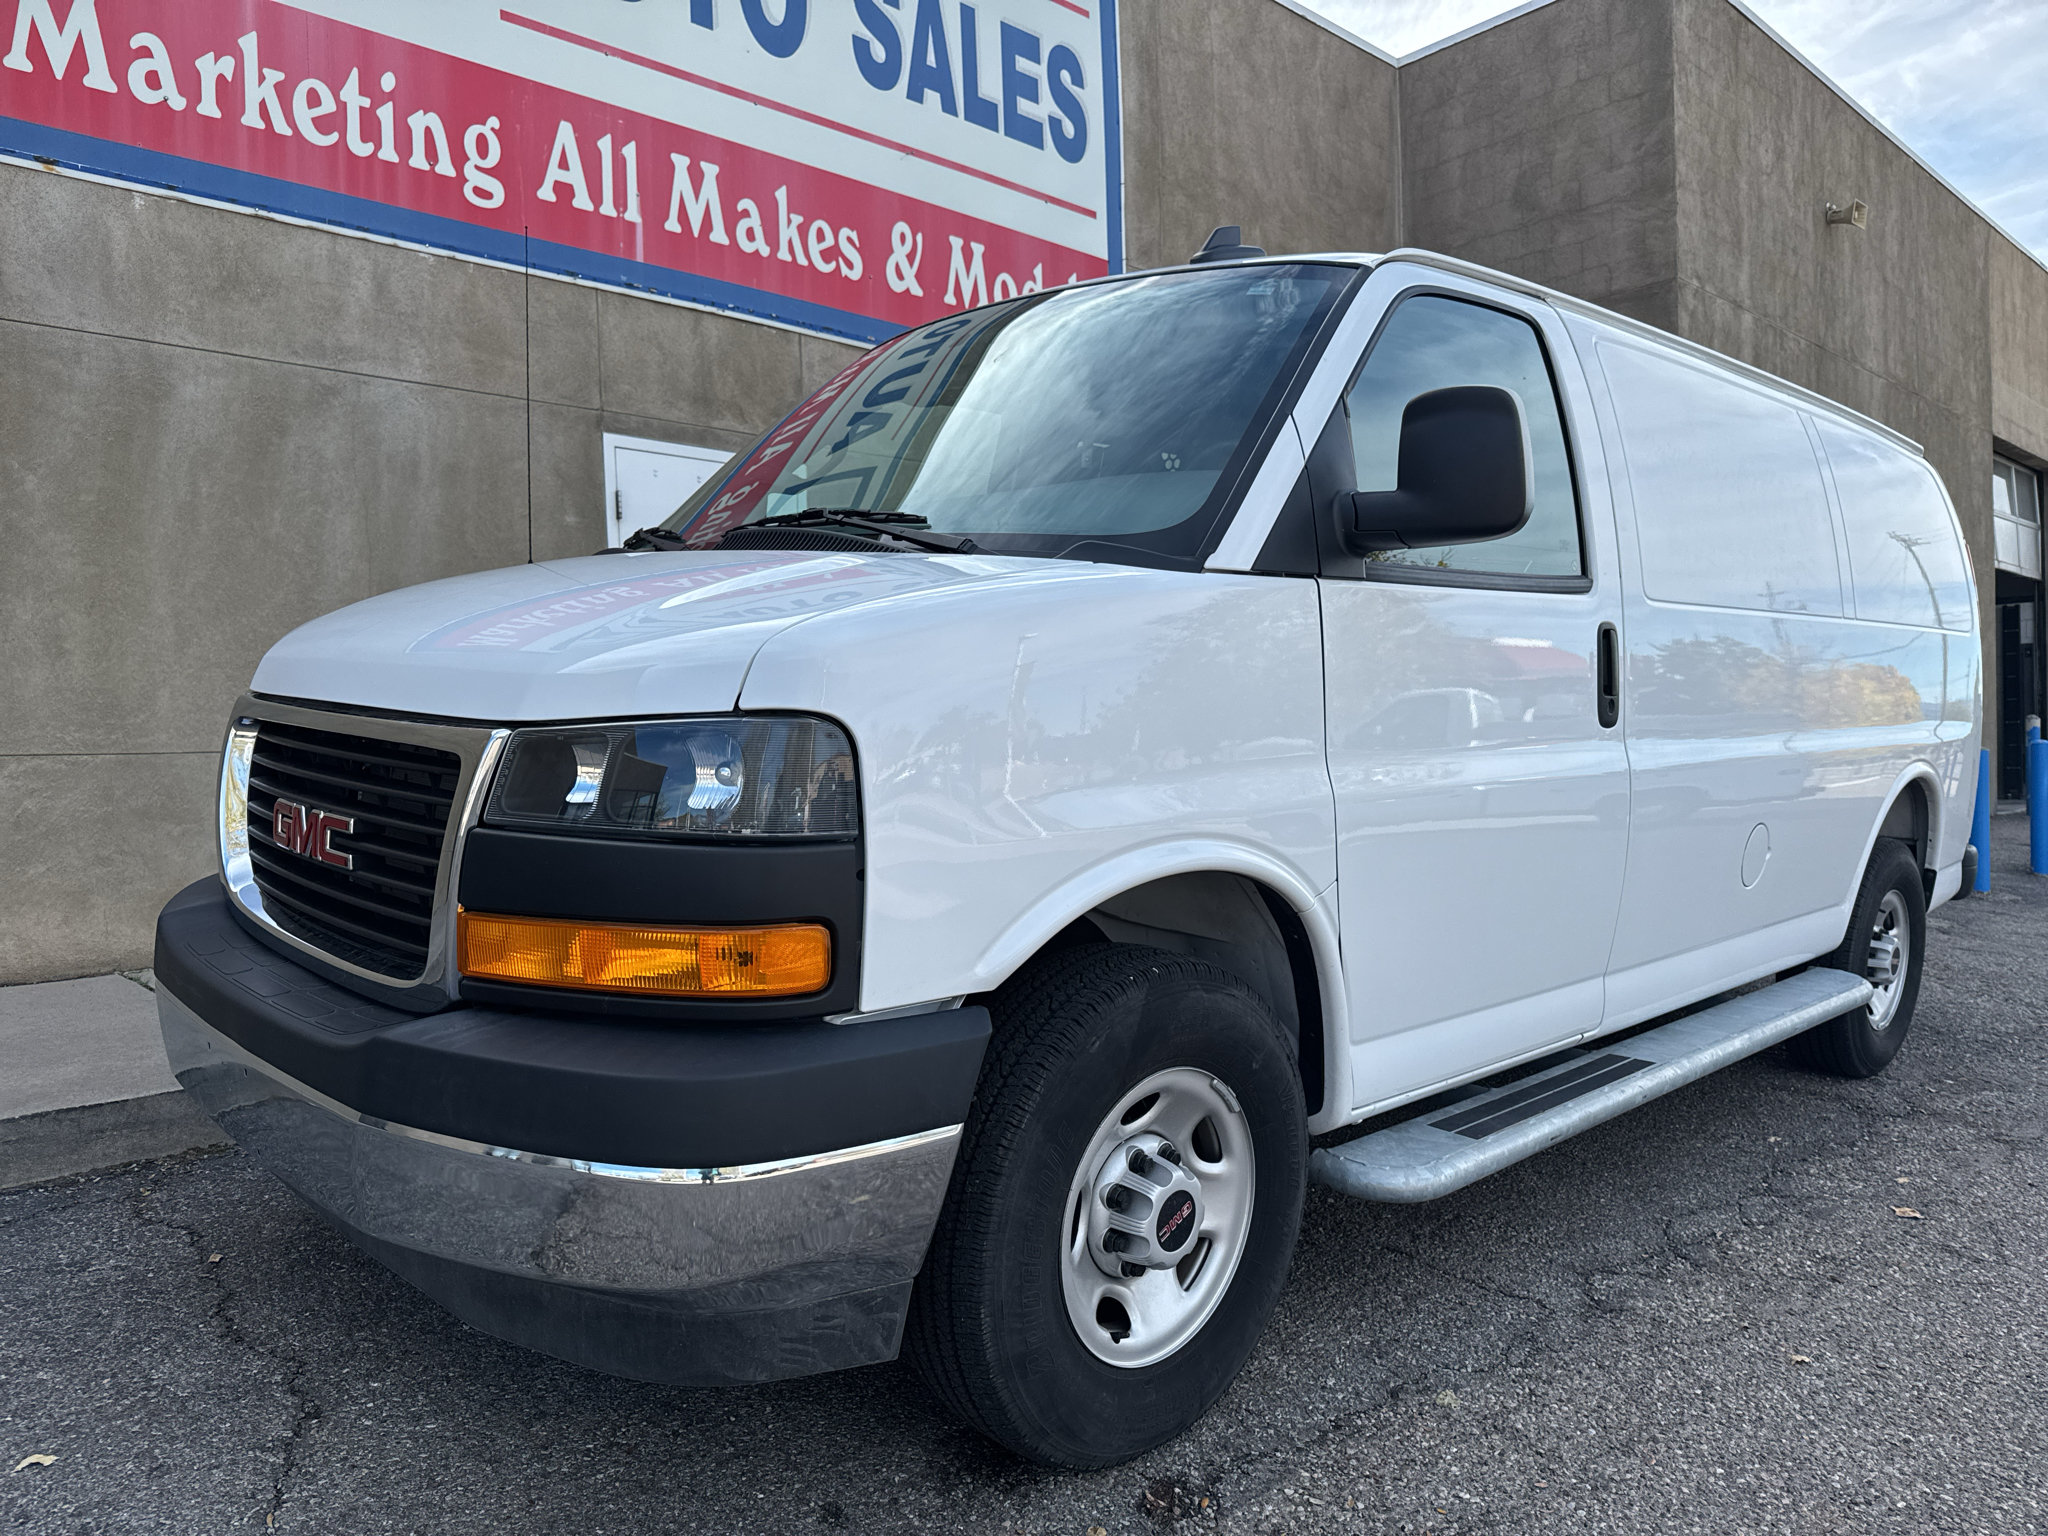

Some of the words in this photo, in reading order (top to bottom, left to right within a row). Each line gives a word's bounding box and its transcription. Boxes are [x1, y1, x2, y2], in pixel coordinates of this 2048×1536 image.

[852, 0, 1088, 164] SALES
[3, 0, 505, 208] Marketing
[536, 120, 642, 223] All
[664, 152, 864, 282] Makes
[886, 221, 924, 298] &
[273, 798, 354, 870] GMC
[1159, 1200, 1193, 1243] GMC
